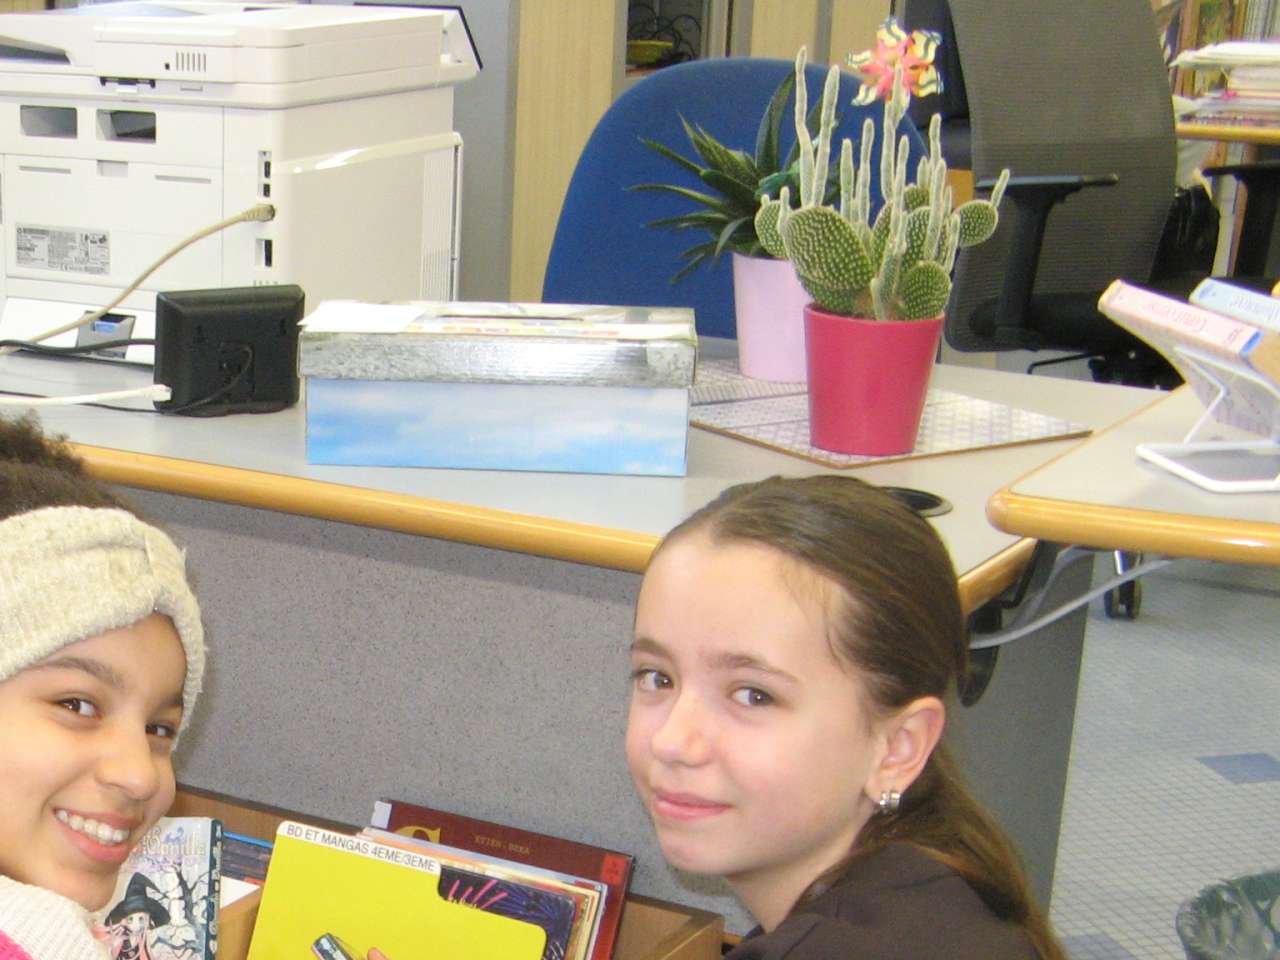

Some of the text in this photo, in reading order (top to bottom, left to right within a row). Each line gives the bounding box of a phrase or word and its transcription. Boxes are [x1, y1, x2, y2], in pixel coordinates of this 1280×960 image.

[286, 824, 435, 872] BD ET MANGAS 4EME/3EME
